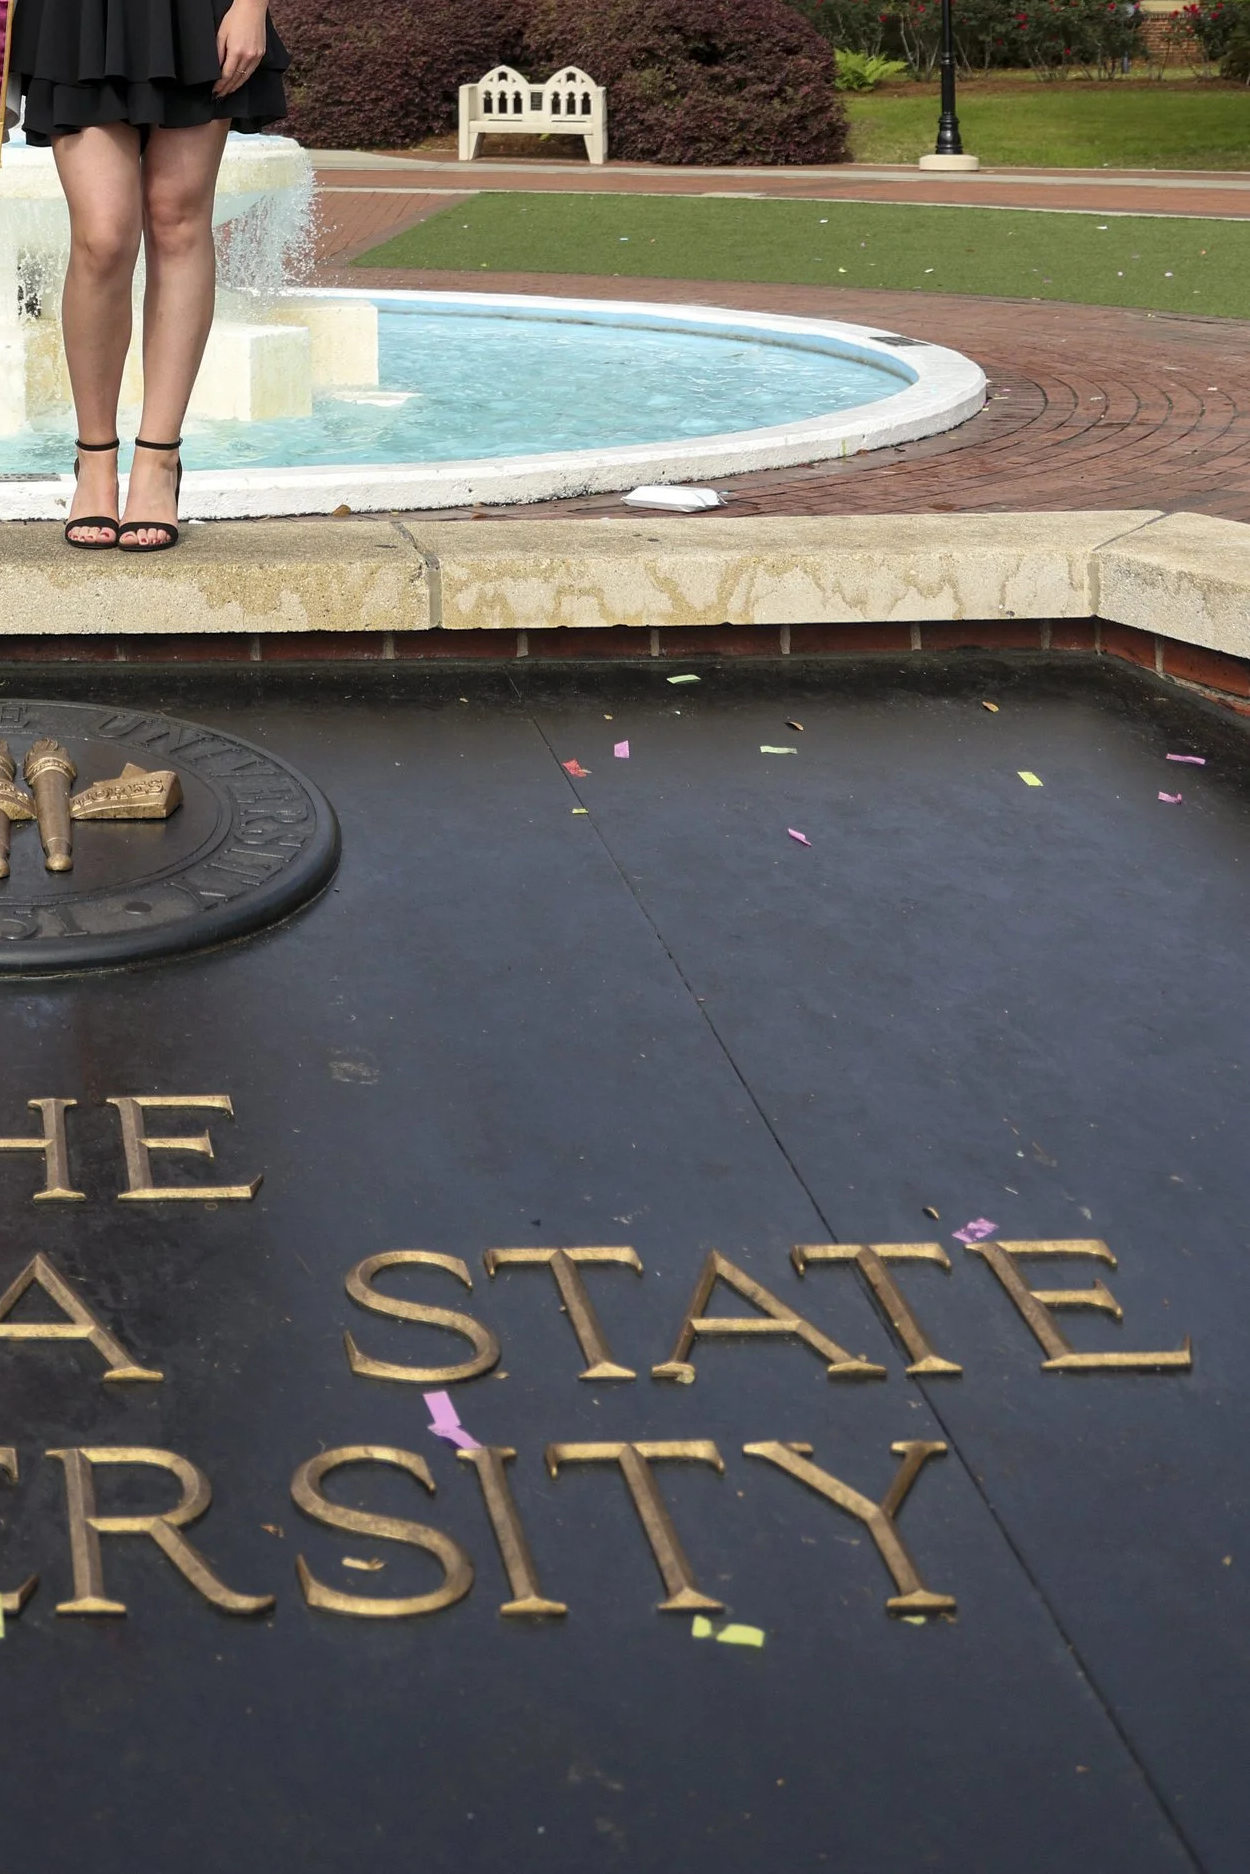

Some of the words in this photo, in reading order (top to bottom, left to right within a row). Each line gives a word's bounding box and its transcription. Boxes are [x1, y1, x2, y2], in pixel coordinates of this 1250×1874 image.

[71, 779, 164, 811] MORES
[98, 713, 309, 911] UNIVERSITY
[344, 1239, 1194, 1383] STATE
